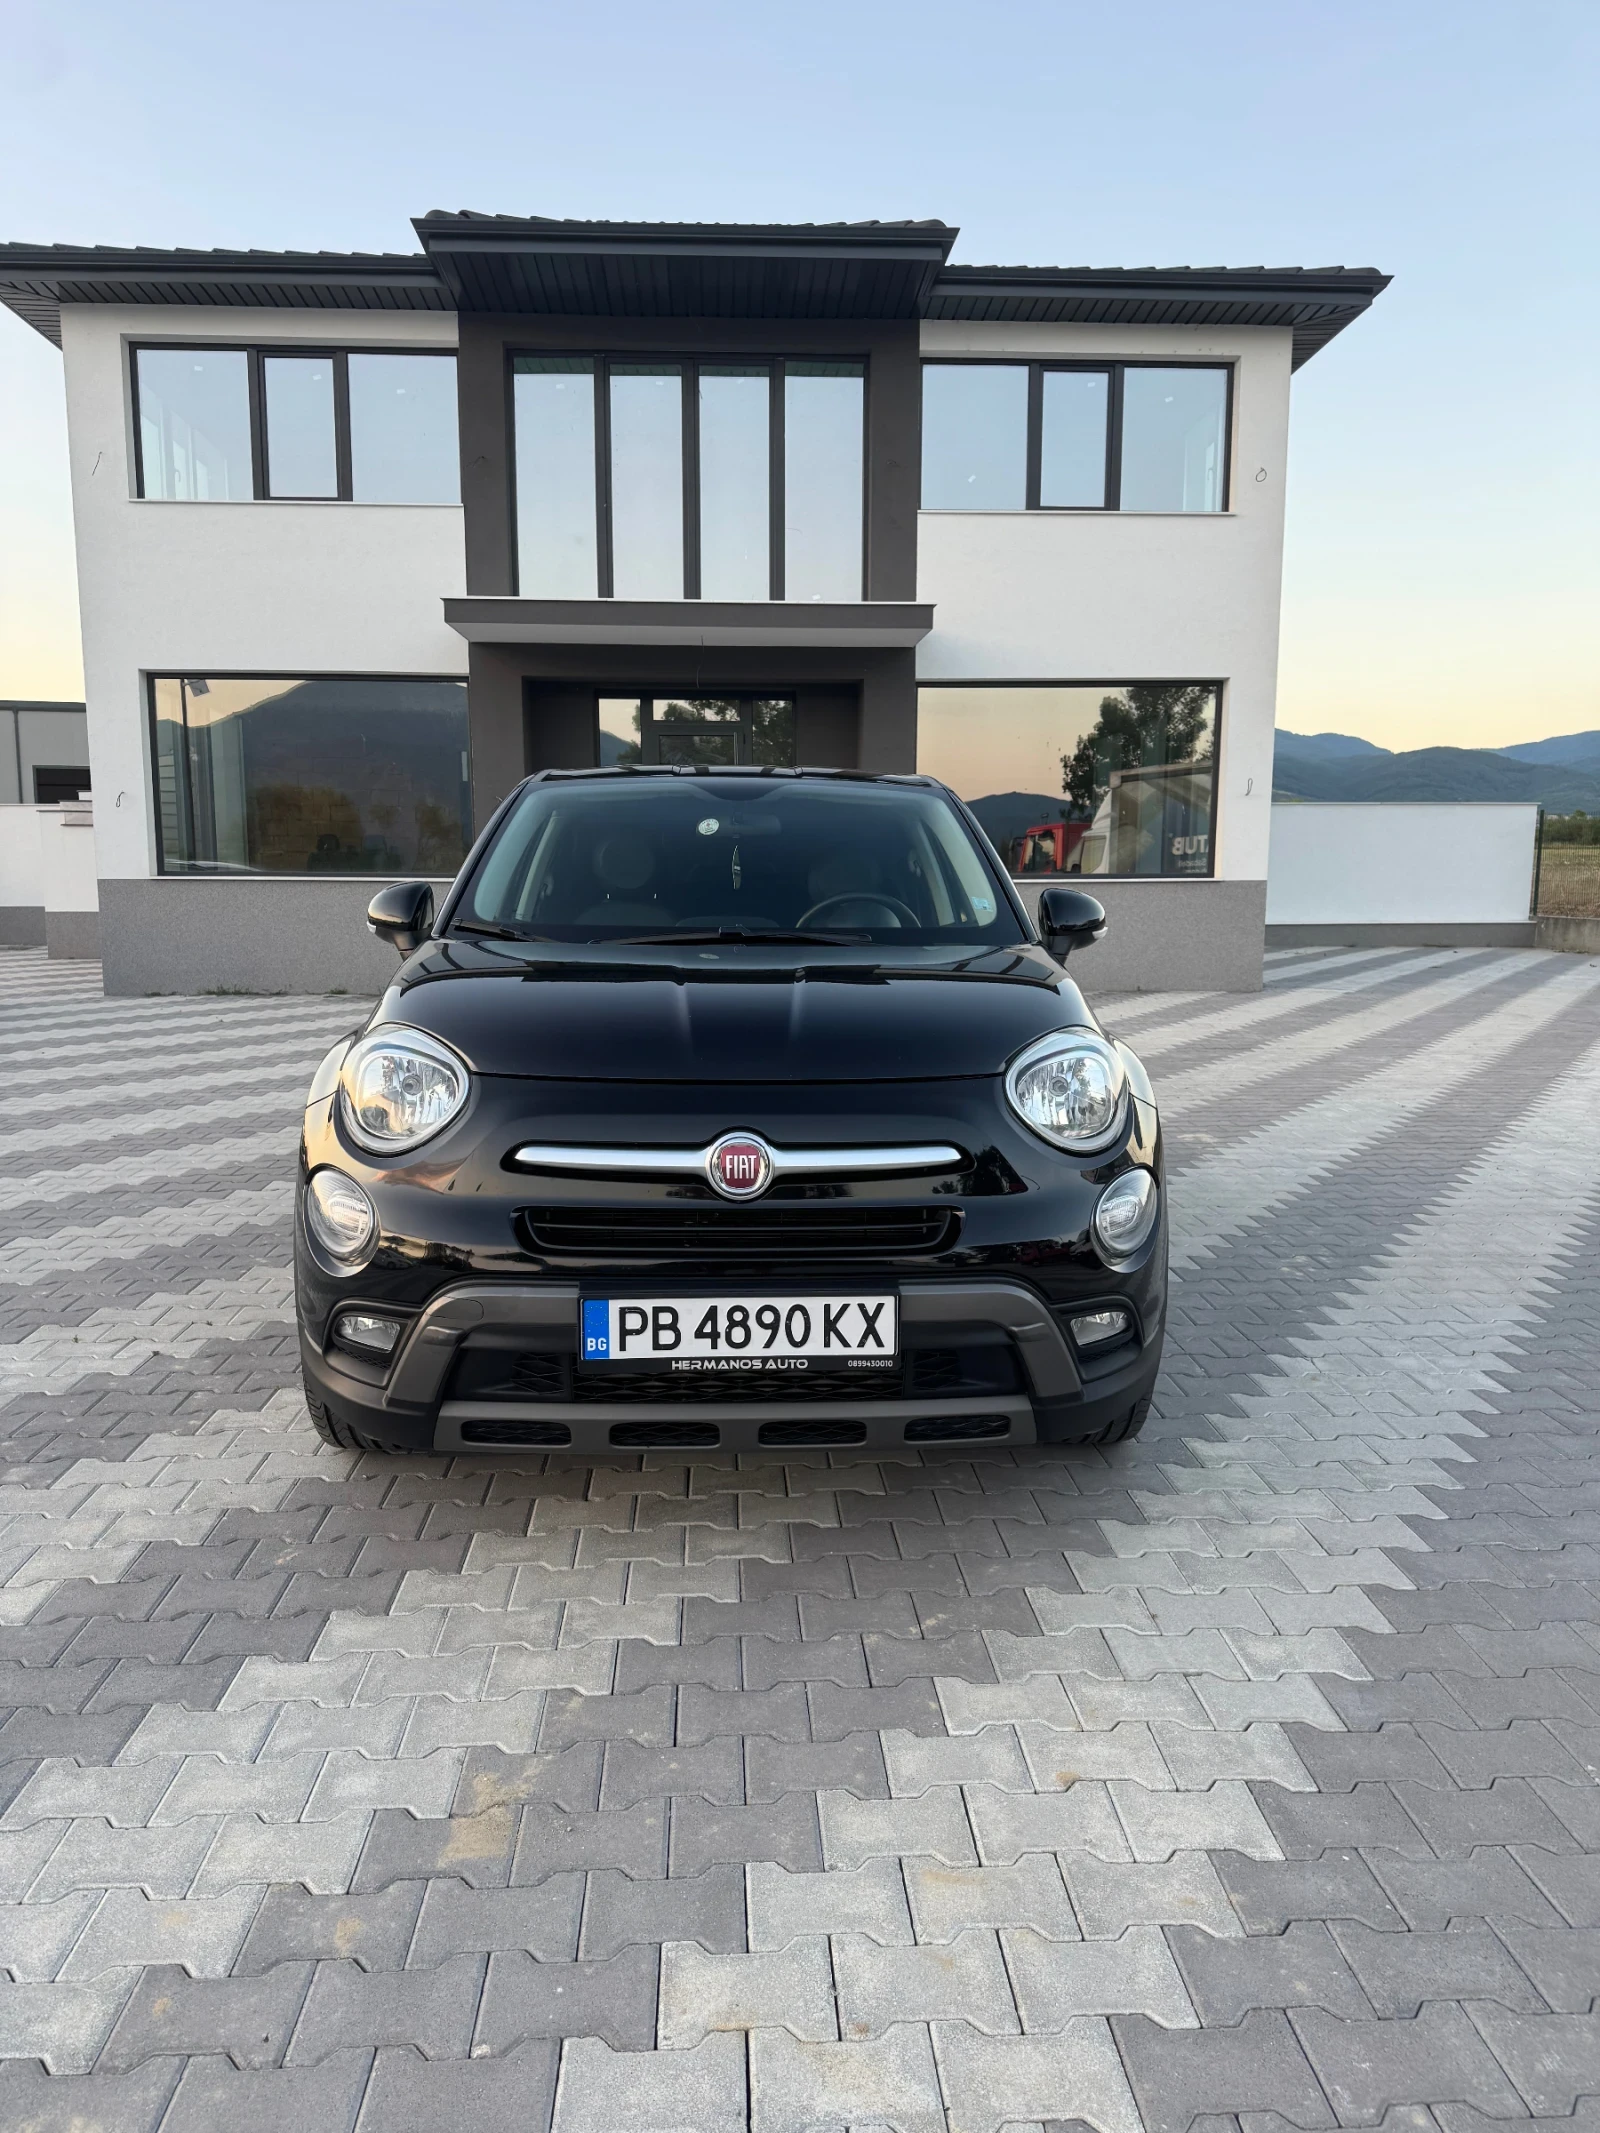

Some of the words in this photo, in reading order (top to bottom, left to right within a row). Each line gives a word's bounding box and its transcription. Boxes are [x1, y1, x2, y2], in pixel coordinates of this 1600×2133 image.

[725, 1154, 757, 1180] FIAT
[618, 1306, 682, 1352] PB
[694, 1304, 811, 1350] 4890
[823, 1302, 886, 1348] KX
[587, 1338, 607, 1351] BG
[671, 1359, 762, 1370] HERMANOS
[765, 1358, 808, 1369] AUTO
